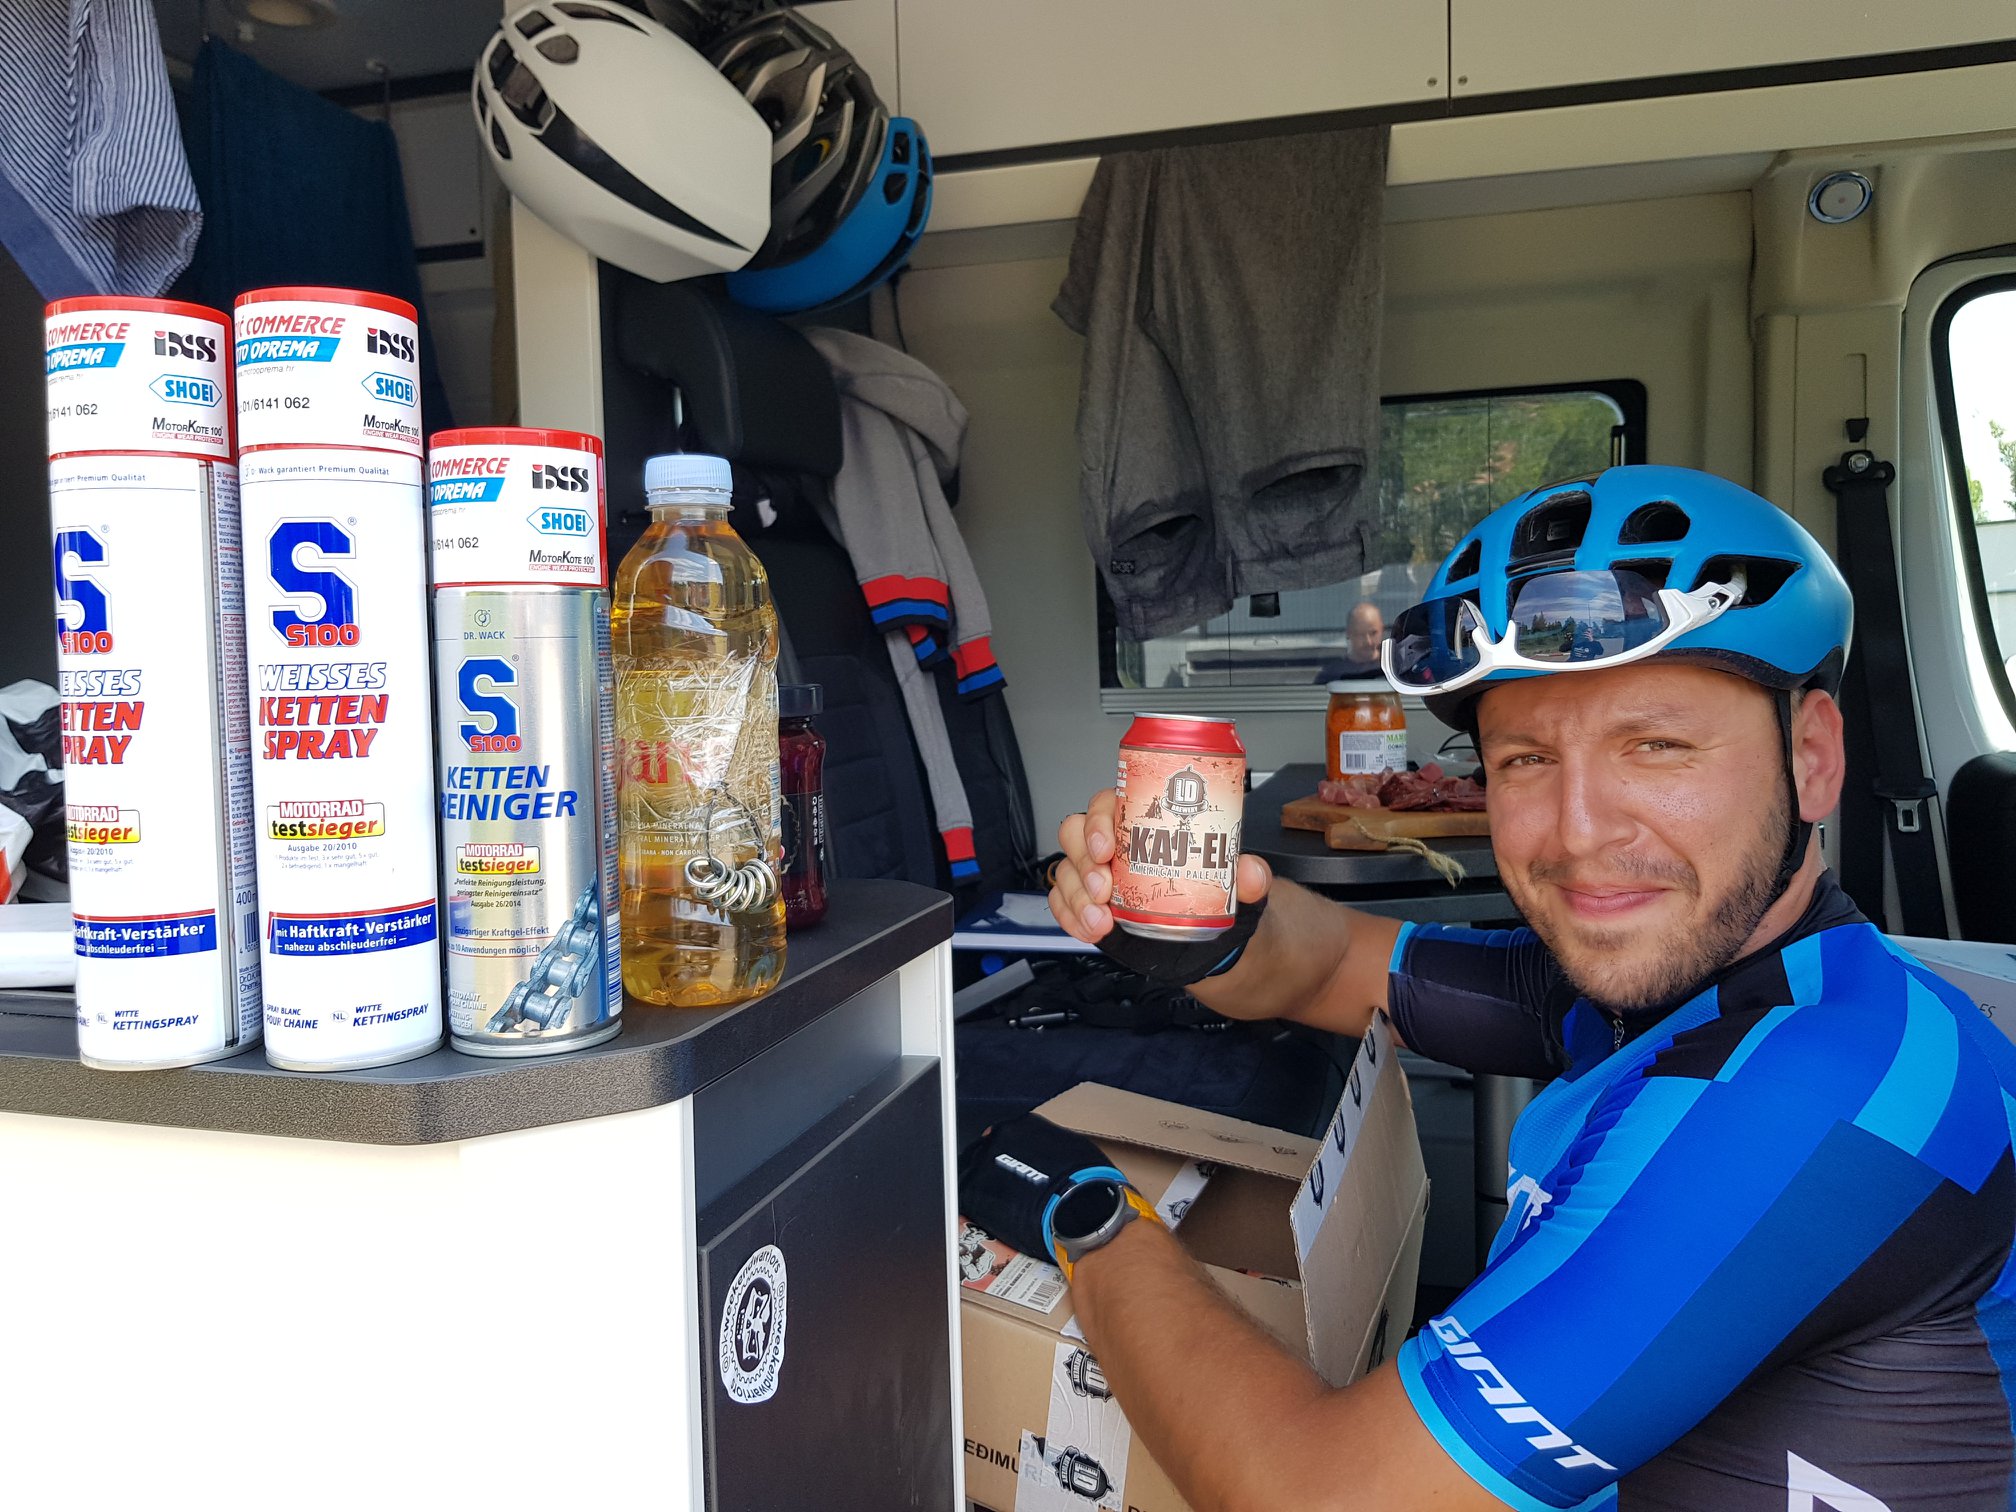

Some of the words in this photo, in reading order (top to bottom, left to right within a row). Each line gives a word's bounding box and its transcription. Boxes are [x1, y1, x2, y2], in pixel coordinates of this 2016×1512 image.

[246, 315, 346, 336] COMMERCE
[251, 340, 320, 359] OPREMA
[165, 379, 214, 402] SHOEI
[376, 377, 413, 403] SHOEI
[75, 404, 98, 416] 062
[285, 397, 310, 409] 062
[277, 466, 316, 475] garantiert
[319, 465, 356, 473] Premium
[358, 467, 390, 475] Qualität
[432, 457, 510, 478] COMMERCE
[77, 474, 109, 483] Premium
[434, 481, 487, 501] OPREMA
[541, 512, 586, 532] SHOEI
[458, 537, 479, 549] 062
[286, 624, 361, 647] S100
[464, 632, 477, 640] DR.
[478, 631, 506, 640] WACK
[60, 669, 142, 697] EISSES
[258, 662, 387, 691] WEISSES
[61, 701, 144, 731] ETTEN
[259, 694, 389, 726] KETTEN
[63, 735, 132, 765] PRAY
[263, 728, 378, 760] SPRAY
[470, 734, 522, 753] S100
[447, 765, 550, 789] KETTEN
[280, 800, 364, 818] MOTORRAD
[441, 790, 578, 821] REINIGER
[1171, 804, 1198, 813] BREWERY
[67, 823, 133, 845] estsieger
[272, 817, 378, 840] testsieger
[288, 844, 320, 853] Ausgabe
[322, 842, 357, 851] 20/2010
[654, 835, 689, 843] MINERAL
[1130, 826, 1229, 869] KAJ-EL
[465, 843, 524, 857] MOTORRAD
[459, 857, 534, 875] testsieger
[1129, 864, 1180, 878] AMERICAN
[1186, 870, 1210, 880] PALE
[1213, 871, 1228, 880] ALE
[470, 900, 494, 909] Ausgabe
[276, 928, 288, 938] mit
[289, 913, 431, 938] Haftkraft-Verstärker
[455, 925, 490, 937] Einzigartiger
[491, 926, 550, 937] Kraftgel-Effekt
[86, 943, 155, 954] abschleuderfrei
[285, 943, 315, 952] nahezu
[318, 935, 397, 951] abschleuderfrei
[461, 944, 507, 955] Anwendungen
[508, 944, 540, 955] möglich
[114, 1010, 139, 1018] WITTE
[280, 1007, 301, 1015] BLANC
[352, 1003, 429, 1027] KETTINGSPRAY
[355, 1003, 382, 1014] WITTE
[112, 1015, 199, 1030] KETTINGSPRAY
[266, 1014, 282, 1026] POUR
[283, 1018, 319, 1029] CHAINE
[995, 1153, 1049, 1185] GIANT
[1428, 1315, 1618, 1471] GIANT
